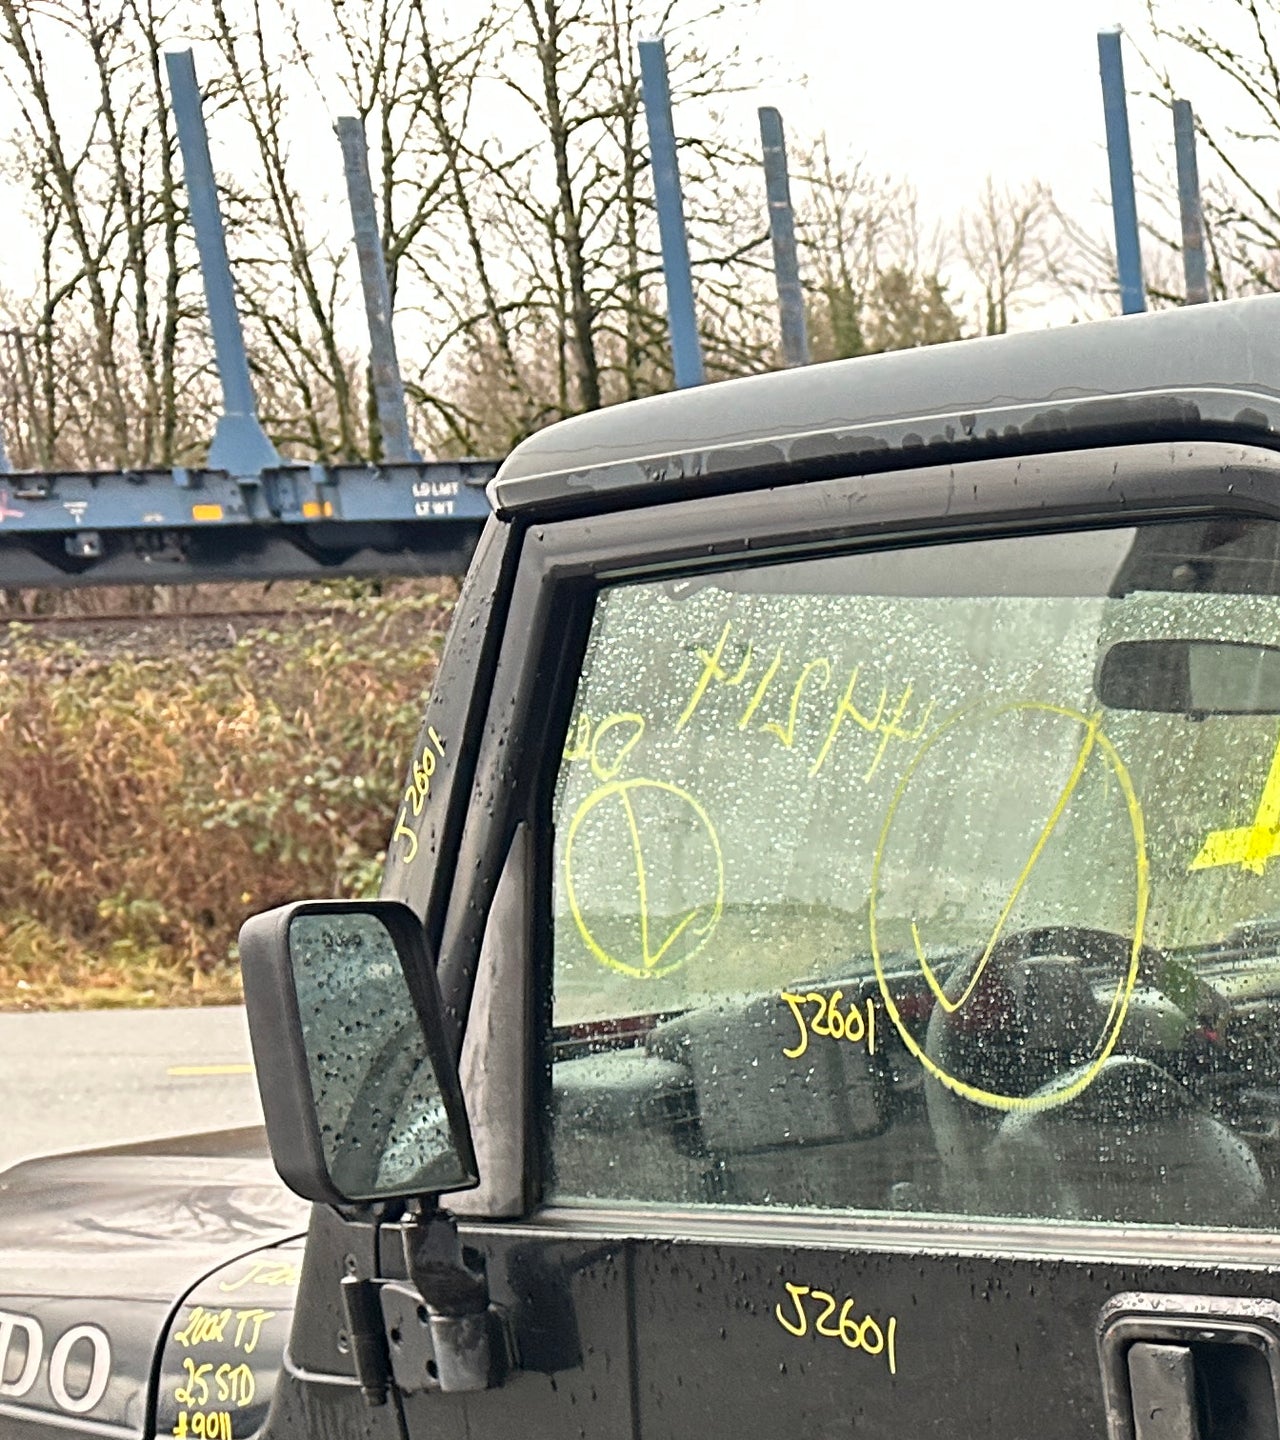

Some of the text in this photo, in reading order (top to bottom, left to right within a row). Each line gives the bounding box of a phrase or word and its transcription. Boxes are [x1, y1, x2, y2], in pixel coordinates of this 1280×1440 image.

[394, 726, 446, 864] J2601
[781, 989, 876, 1059] J2601
[235, 1309, 275, 1354] TJ
[776, 1282, 896, 1375] J2601
[217, 1362, 256, 1407] STD
